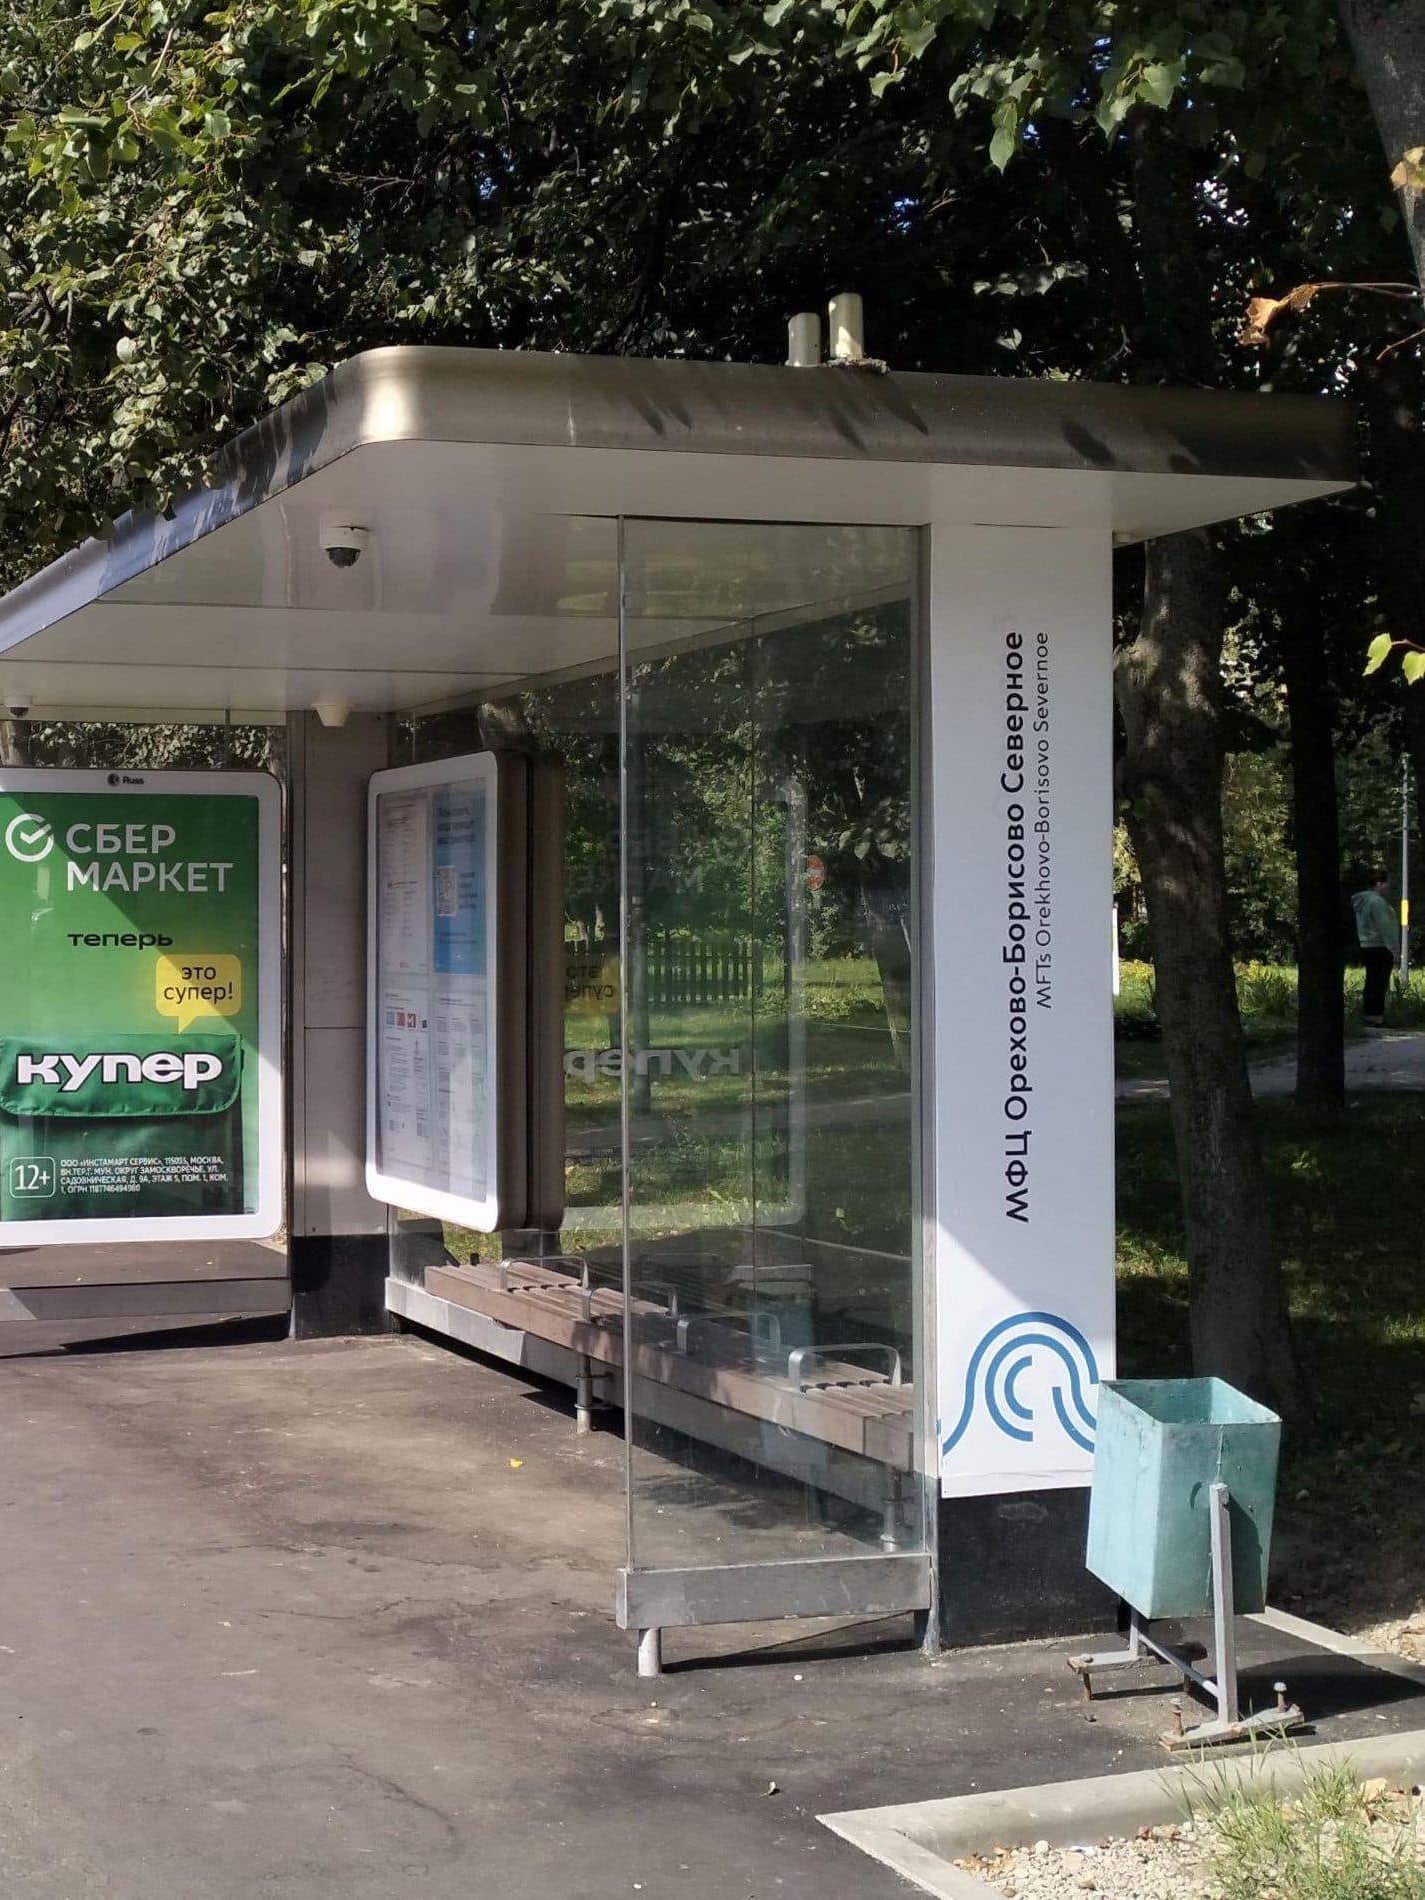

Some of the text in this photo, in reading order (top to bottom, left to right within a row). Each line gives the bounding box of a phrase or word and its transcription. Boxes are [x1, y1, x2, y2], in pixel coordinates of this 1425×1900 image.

[1033, 632, 1052, 1009] MFTs Orekhovo-Borisovo Severnoe
[66, 823, 176, 854] СБЕР
[67, 861, 234, 892] МАРКЕТ
[67, 933, 174, 950] теперь
[1001, 632, 1033, 1223] МФЦ Орехово-Борисово Северное
[181, 966, 217, 981] это
[163, 981, 233, 1005] супер!
[16, 1052, 224, 1092] купер
[14, 1164, 51, 1190] 12+
[60, 1159, 79, 1167] ООО
